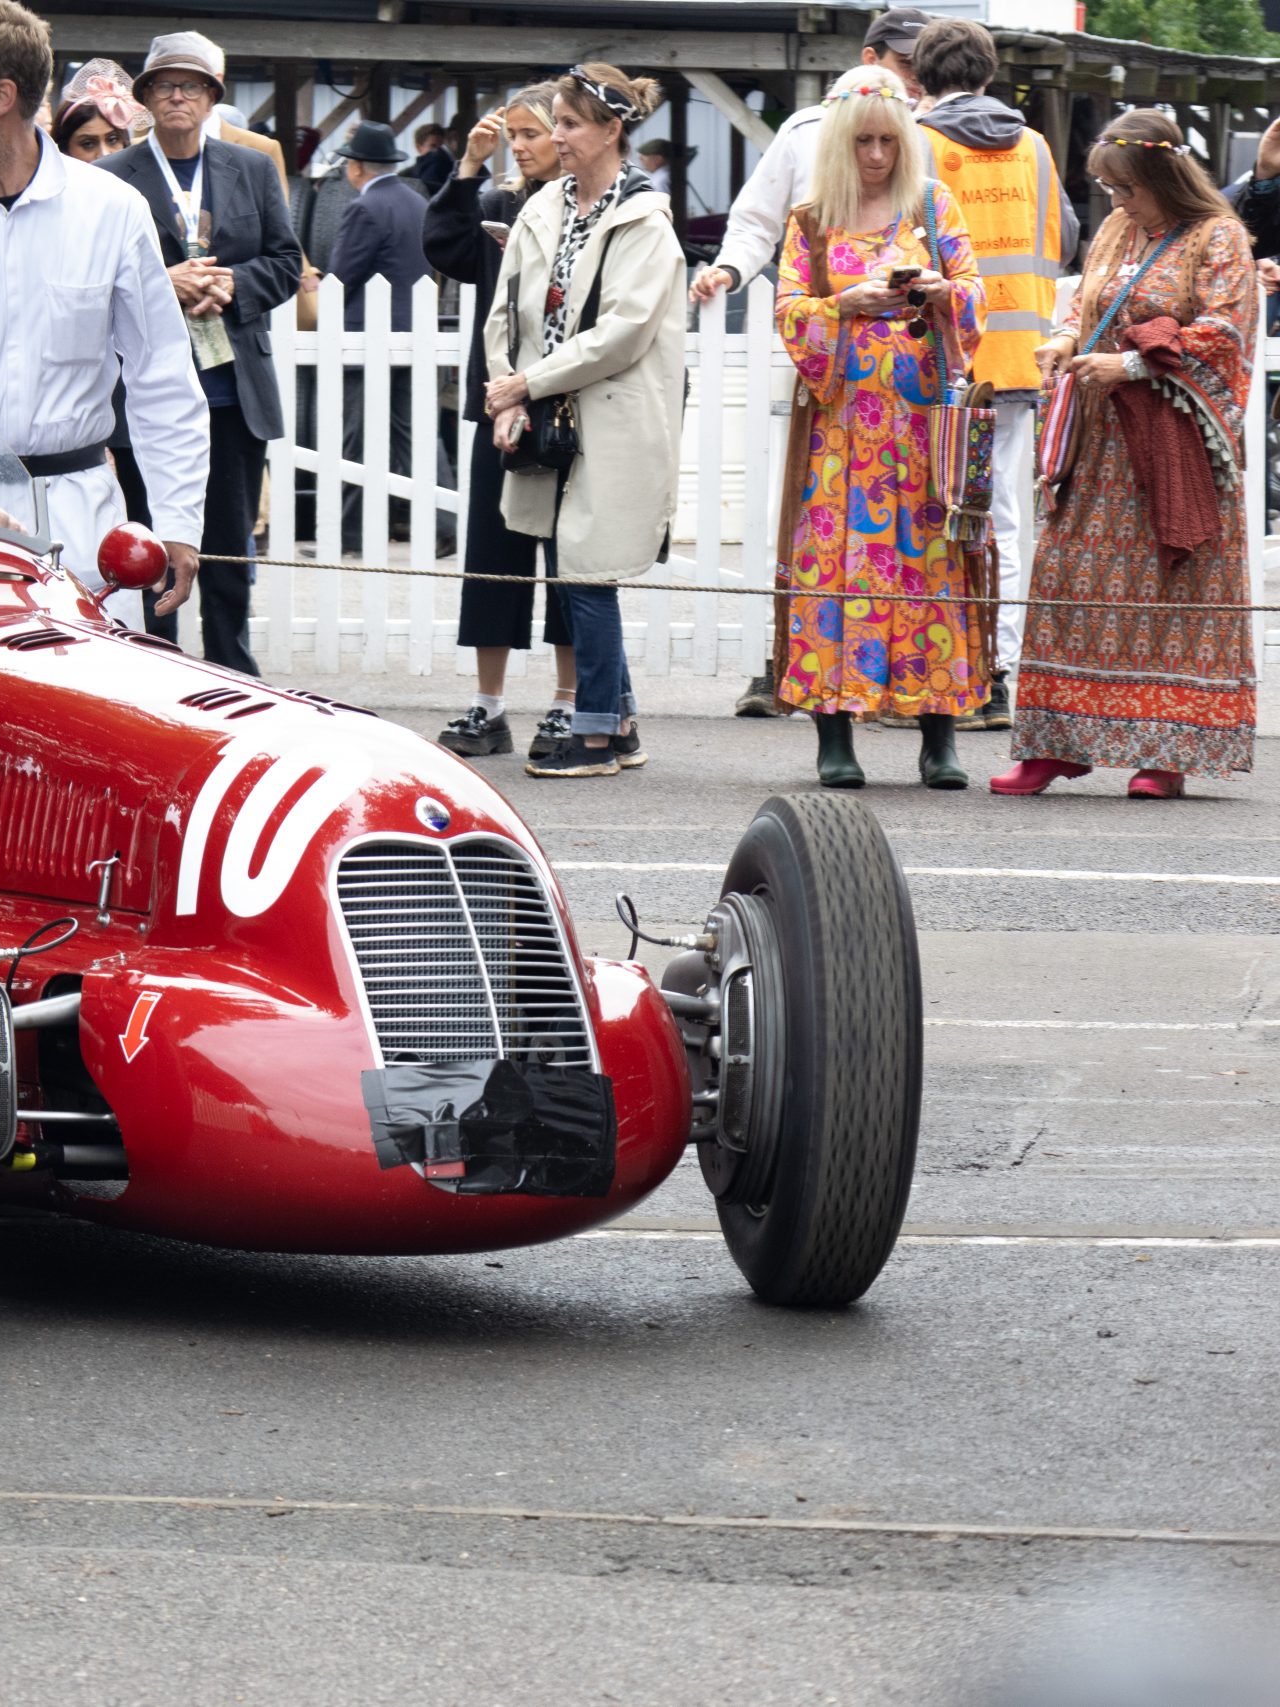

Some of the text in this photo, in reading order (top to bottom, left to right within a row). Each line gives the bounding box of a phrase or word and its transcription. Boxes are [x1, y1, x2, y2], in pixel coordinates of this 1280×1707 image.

[961, 187, 1027, 205] MARSHAL
[970, 236, 1031, 251] anksMars
[176, 731, 374, 918] 10
